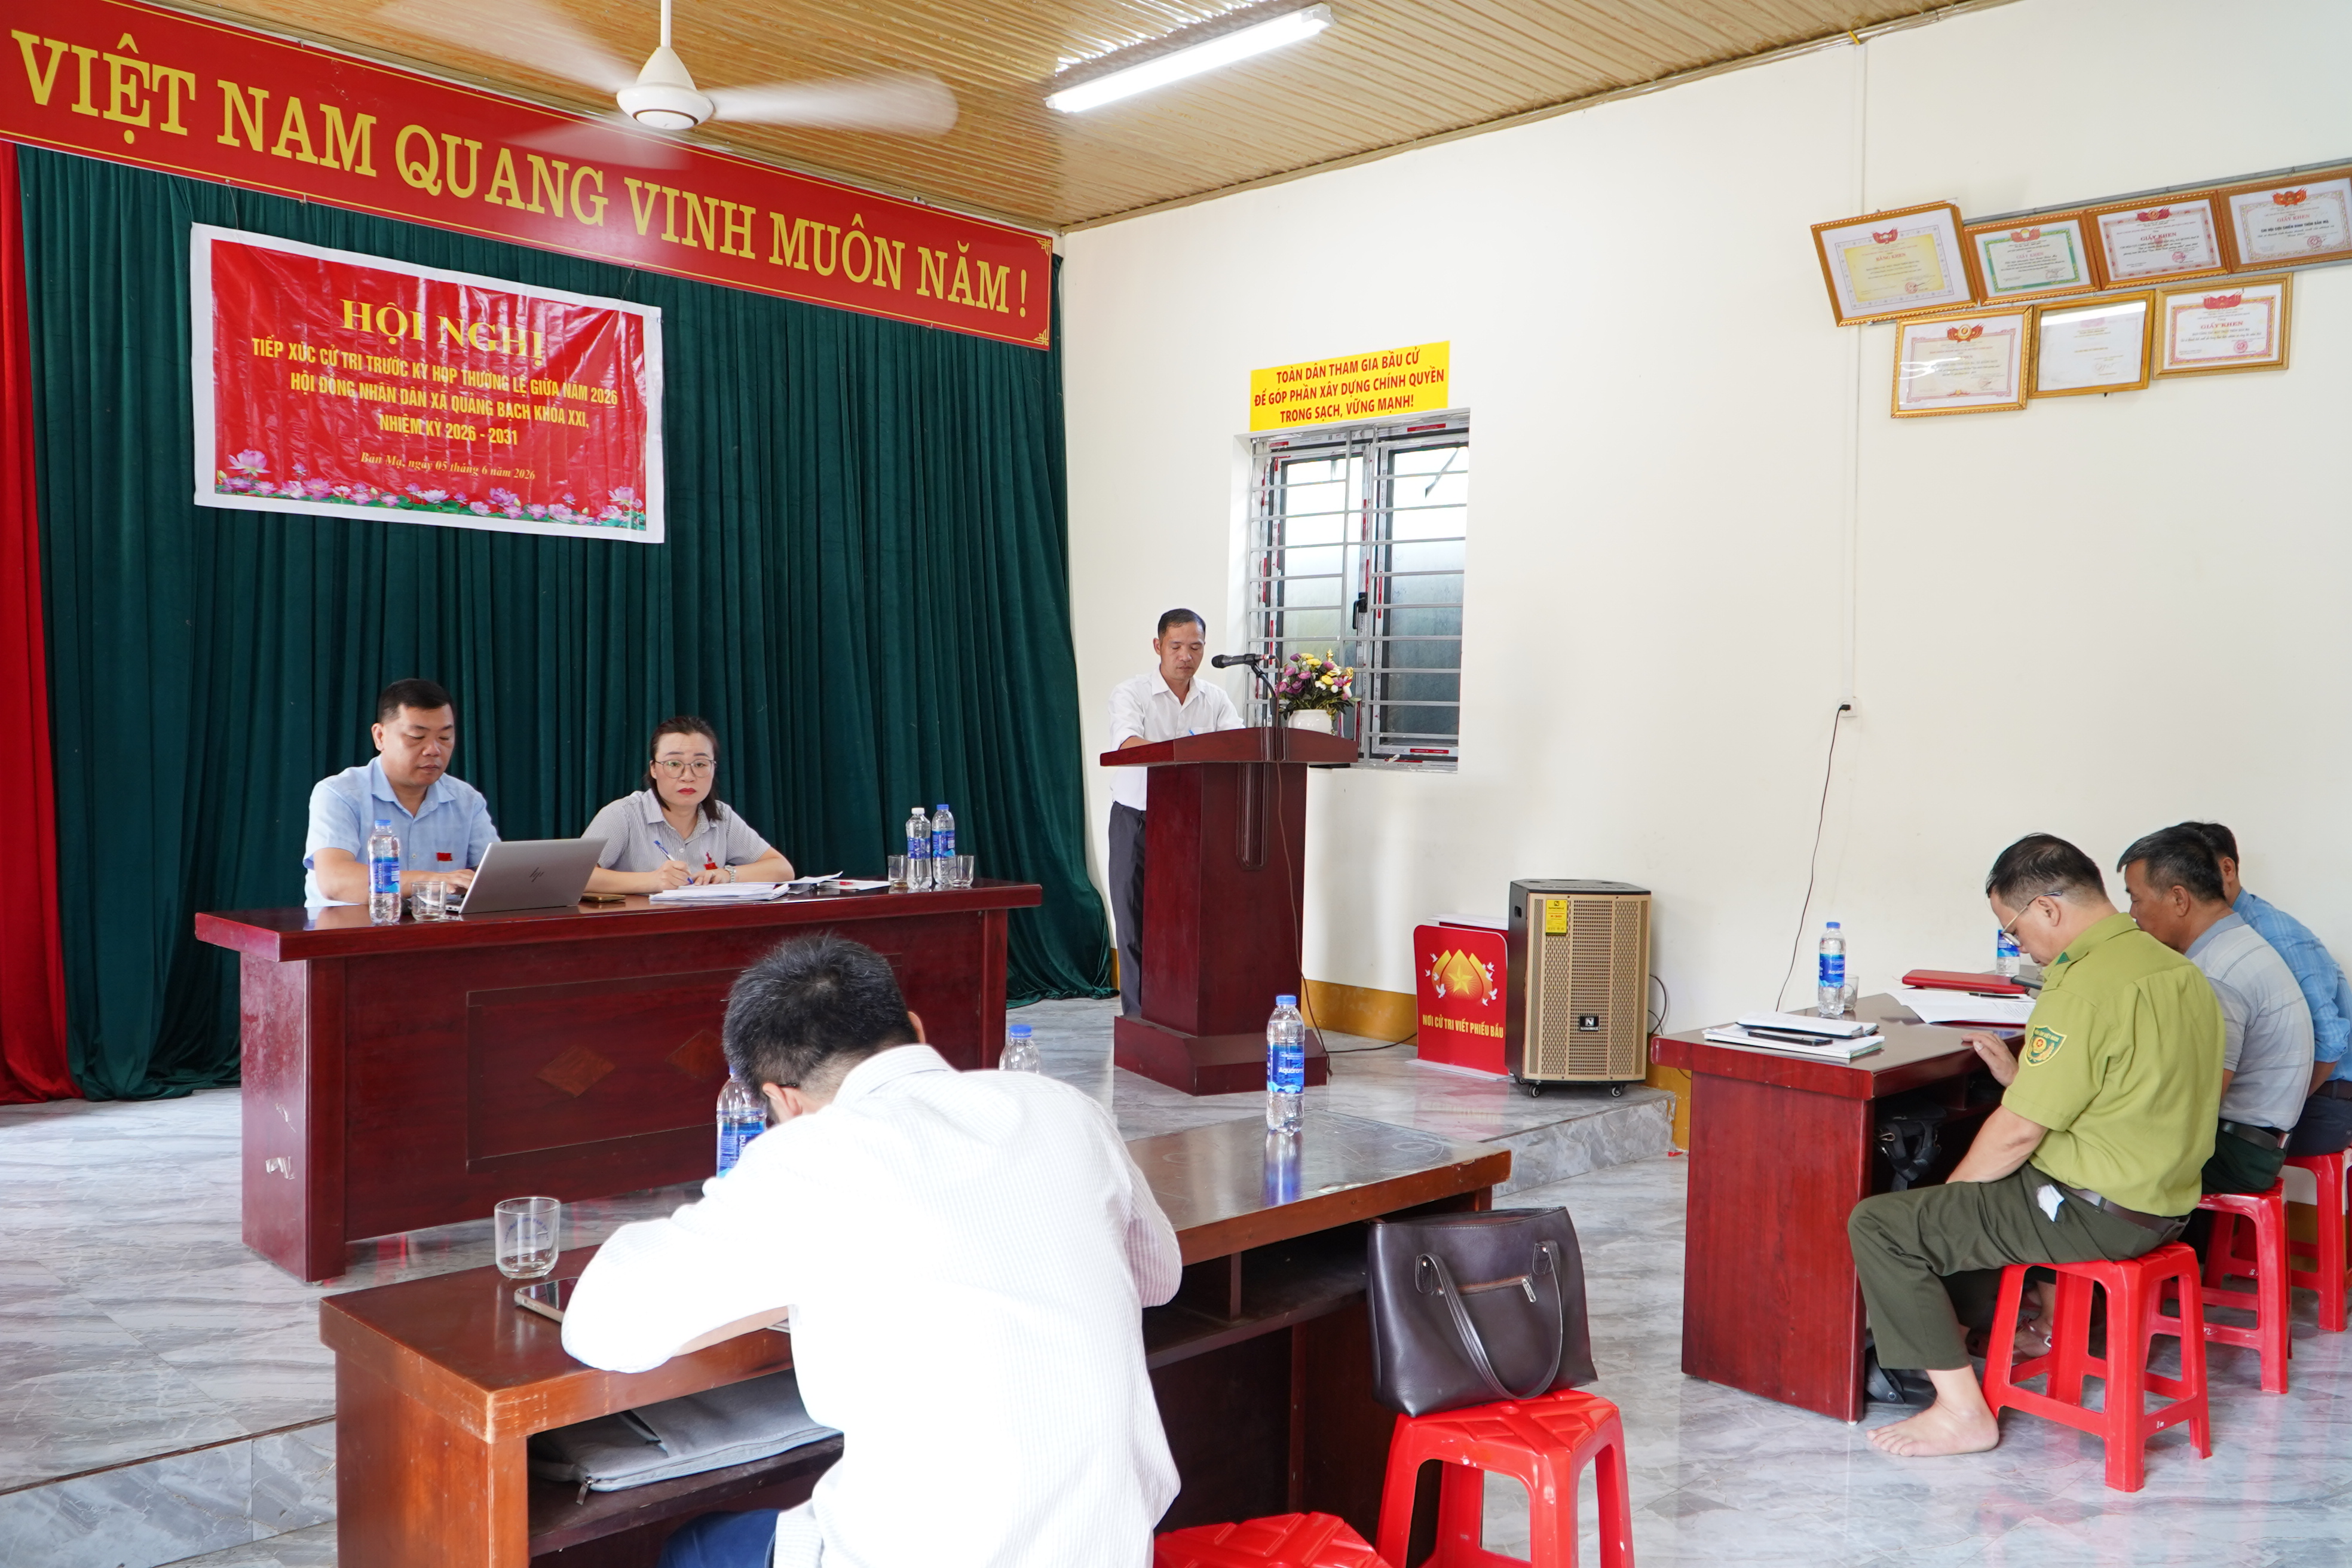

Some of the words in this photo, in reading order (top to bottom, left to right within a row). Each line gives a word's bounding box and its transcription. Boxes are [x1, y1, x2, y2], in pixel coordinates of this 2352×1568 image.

[11, 30, 195, 144] VIỆT
[217, 79, 376, 177] NAM
[395, 124, 608, 226] QUANG
[624, 176, 756, 259] VINH
[769, 213, 904, 291] MUÔN
[917, 240, 1010, 314] NĂM
[339, 299, 425, 345] HỘI
[436, 315, 543, 367] NGHỊ
[252, 335, 283, 359] TIẾP
[288, 341, 316, 363] XÚC
[320, 344, 339, 367] CỬ
[341, 351, 362, 370] TRI
[366, 355, 408, 377] TRƯỚC
[432, 365, 458, 387] HỌP
[461, 369, 509, 391] THƯỜNG
[513, 374, 527, 397] LỆ
[530, 376, 560, 396] GIỮA
[563, 381, 587, 401] NĂM
[590, 387, 618, 406] 2026
[1276, 367, 1302, 384] TOÀN
[1306, 363, 1326, 379] DÂN
[1329, 360, 1358, 376] THAM
[1361, 357, 1378, 372] GIA
[1382, 350, 1402, 368] BẦU
[1405, 346, 1420, 365] CỬ
[290, 370, 314, 395] HỘI
[318, 373, 357, 399] ĐỒNG
[359, 382, 396, 403] NHÂN
[400, 386, 427, 408] DÂN
[431, 390, 448, 410] XÃ
[451, 392, 494, 416] QUẢNG
[497, 402, 530, 421] BẠCH
[568, 409, 589, 429] XXI,
[1254, 388, 1266, 407] ĐỂ
[1269, 388, 1287, 405] GÓP
[1290, 383, 1317, 403] PHẦN
[1320, 381, 1338, 399] XÂY
[1342, 379, 1370, 396] DỰNG
[1373, 372, 1405, 391] CHÍNH
[1409, 366, 1444, 387] QUYỀN
[1281, 408, 1312, 423] TRONG
[1315, 403, 1343, 421] SẠCH,
[1346, 398, 1374, 415] VỮNG
[1377, 394, 1414, 414] MẠNH!
[379, 414, 422, 437] NHIỆM
[425, 418, 442, 438] KỲ
[445, 422, 476, 442] 2026
[488, 428, 517, 445] 2031
[361, 452, 382, 464] Bản
[408, 458, 433, 473] ngày
[435, 460, 448, 471] 05
[450, 461, 479, 476] tháng
[482, 464, 488, 474] 6
[490, 467, 510, 477] năm
[513, 468, 535, 480] 2026
[1423, 1014, 1434, 1027] NƠI
[1435, 1014, 1444, 1028] CỬ
[1444, 1018, 1454, 1030] TRI
[1455, 1018, 1469, 1033] VIẾT
[1470, 1021, 1489, 1036] PHIẾU
